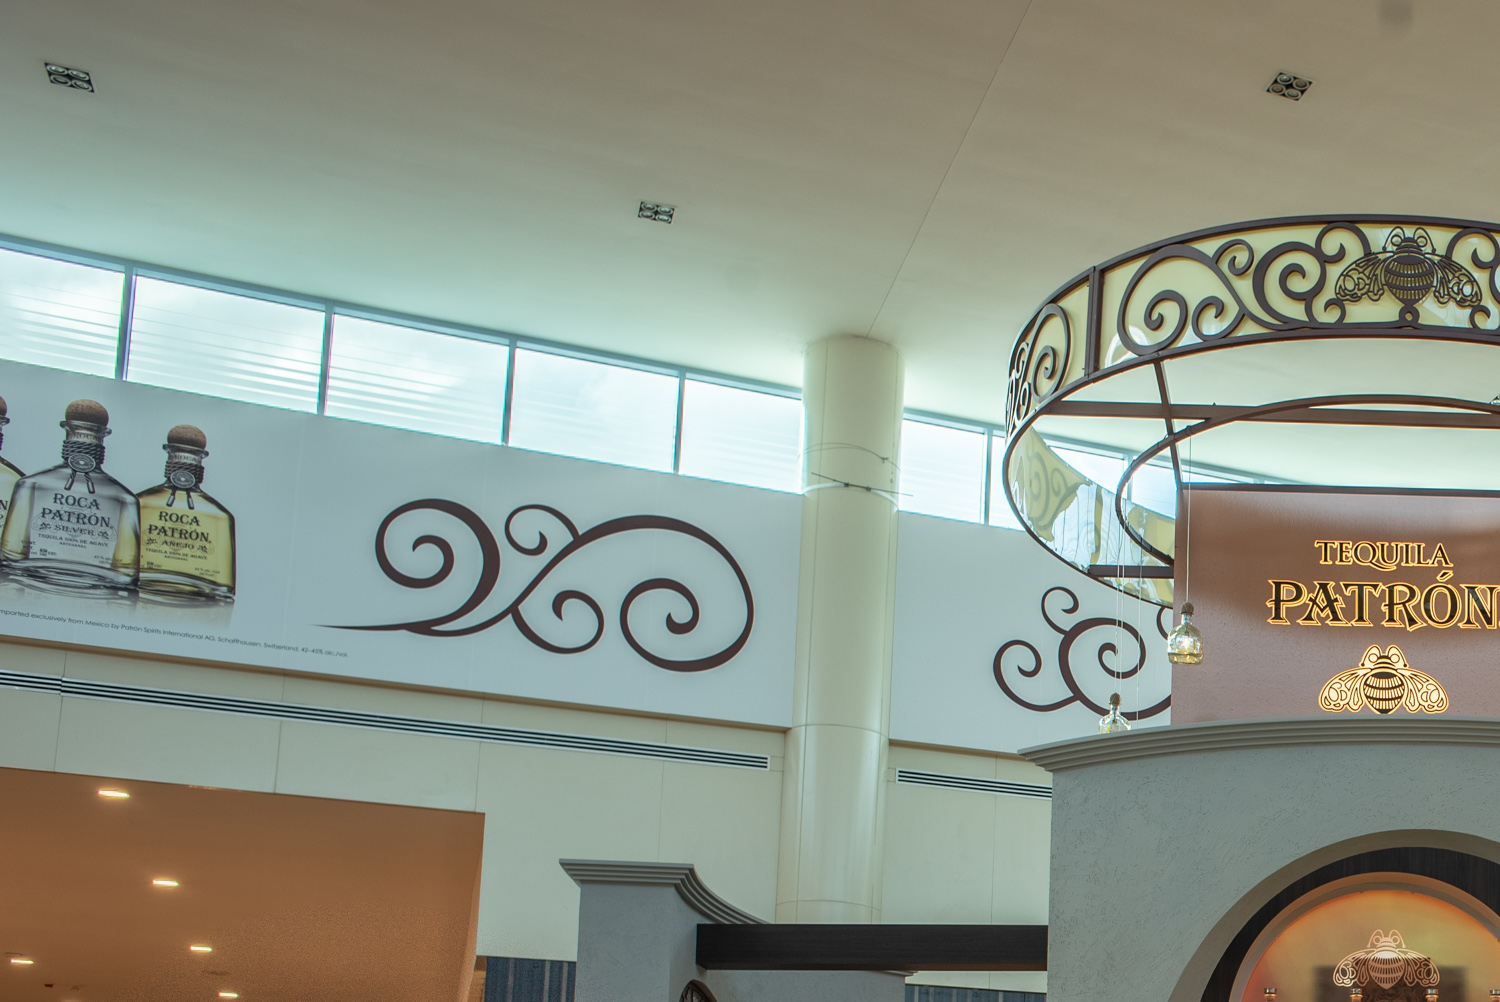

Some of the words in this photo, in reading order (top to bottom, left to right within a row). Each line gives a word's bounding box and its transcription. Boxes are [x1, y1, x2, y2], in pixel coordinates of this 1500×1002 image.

[53, 493, 101, 510] ROCA
[40, 507, 111, 528] PATRÓN
[159, 511, 201, 527] ROCA
[38, 533, 63, 541] TEQUILA
[54, 524, 95, 536] SILVER
[148, 524, 209, 543] PATRÓN
[161, 539, 195, 550] AÑEJO
[1314, 539, 1453, 571] TEQUILA
[31, 613, 67, 623] exclusively
[68, 617, 84, 625] from
[85, 620, 110, 628] Mexico
[121, 624, 143, 632] Patrón
[143, 627, 162, 635] Spirits
[163, 630, 203, 639] International
